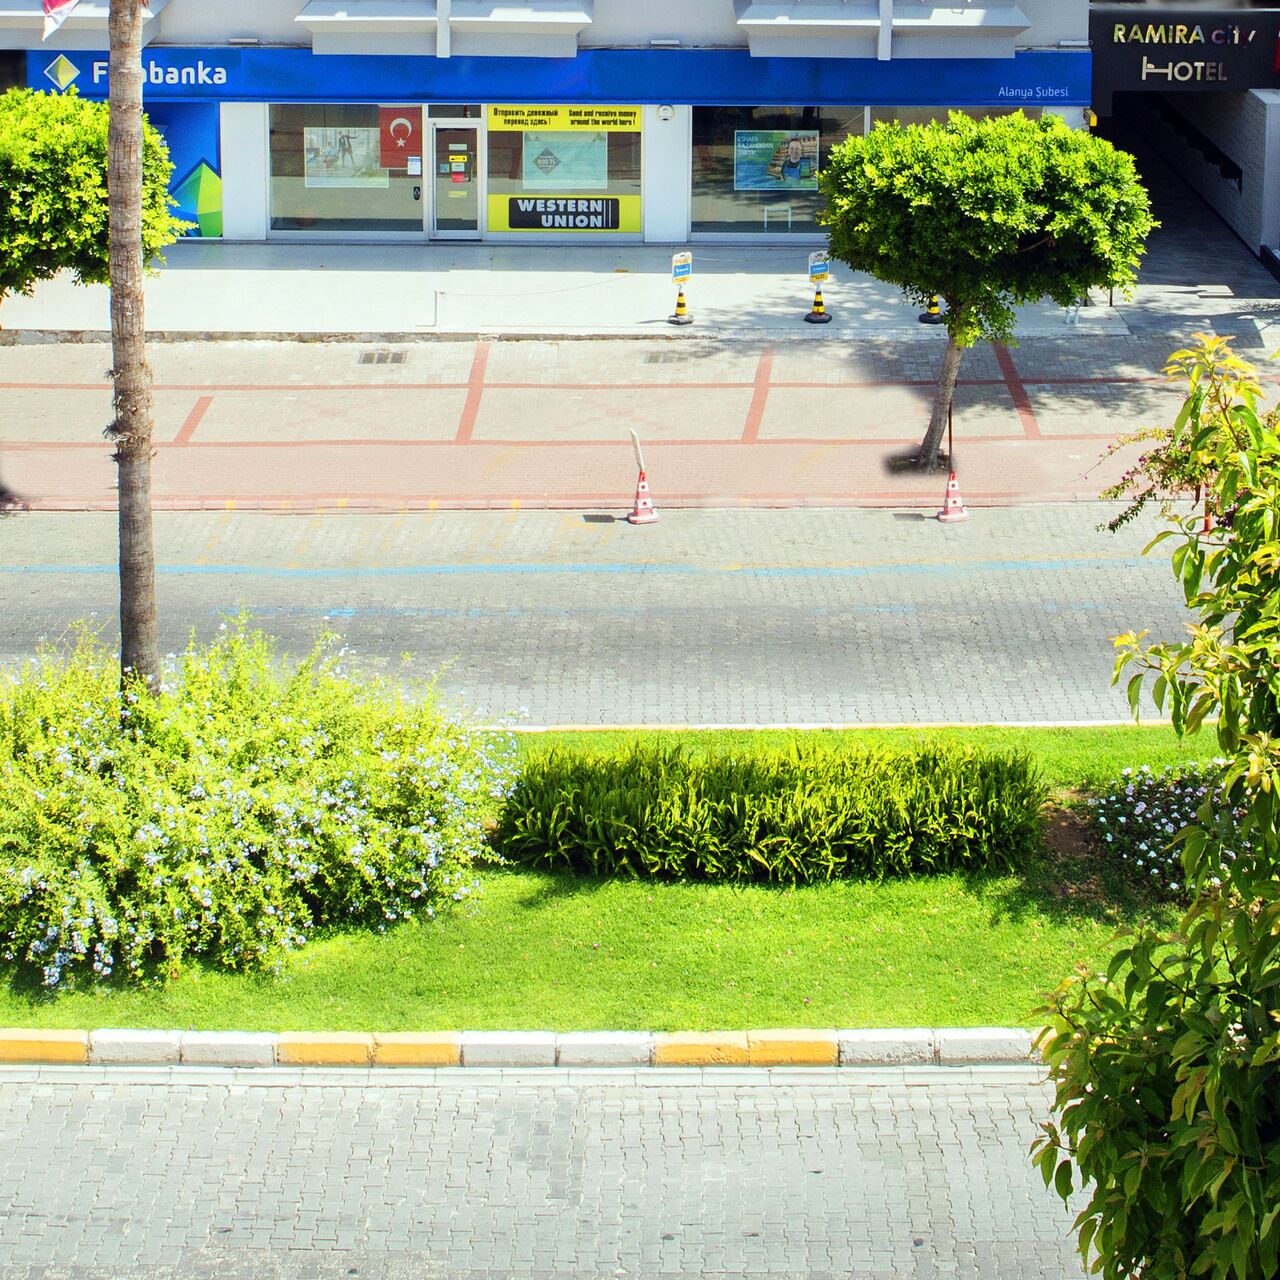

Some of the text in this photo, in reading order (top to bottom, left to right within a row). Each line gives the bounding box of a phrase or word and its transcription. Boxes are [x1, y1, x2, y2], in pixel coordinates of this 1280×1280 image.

[1113, 23, 1205, 44] RAMIRA
[93, 61, 227, 84] Fbanka
[1142, 56, 1227, 81] HOTEL
[998, 86, 1068, 99] Alanya Şubesi
[517, 199, 603, 212] WESTERN
[541, 215, 603, 227] UNION
